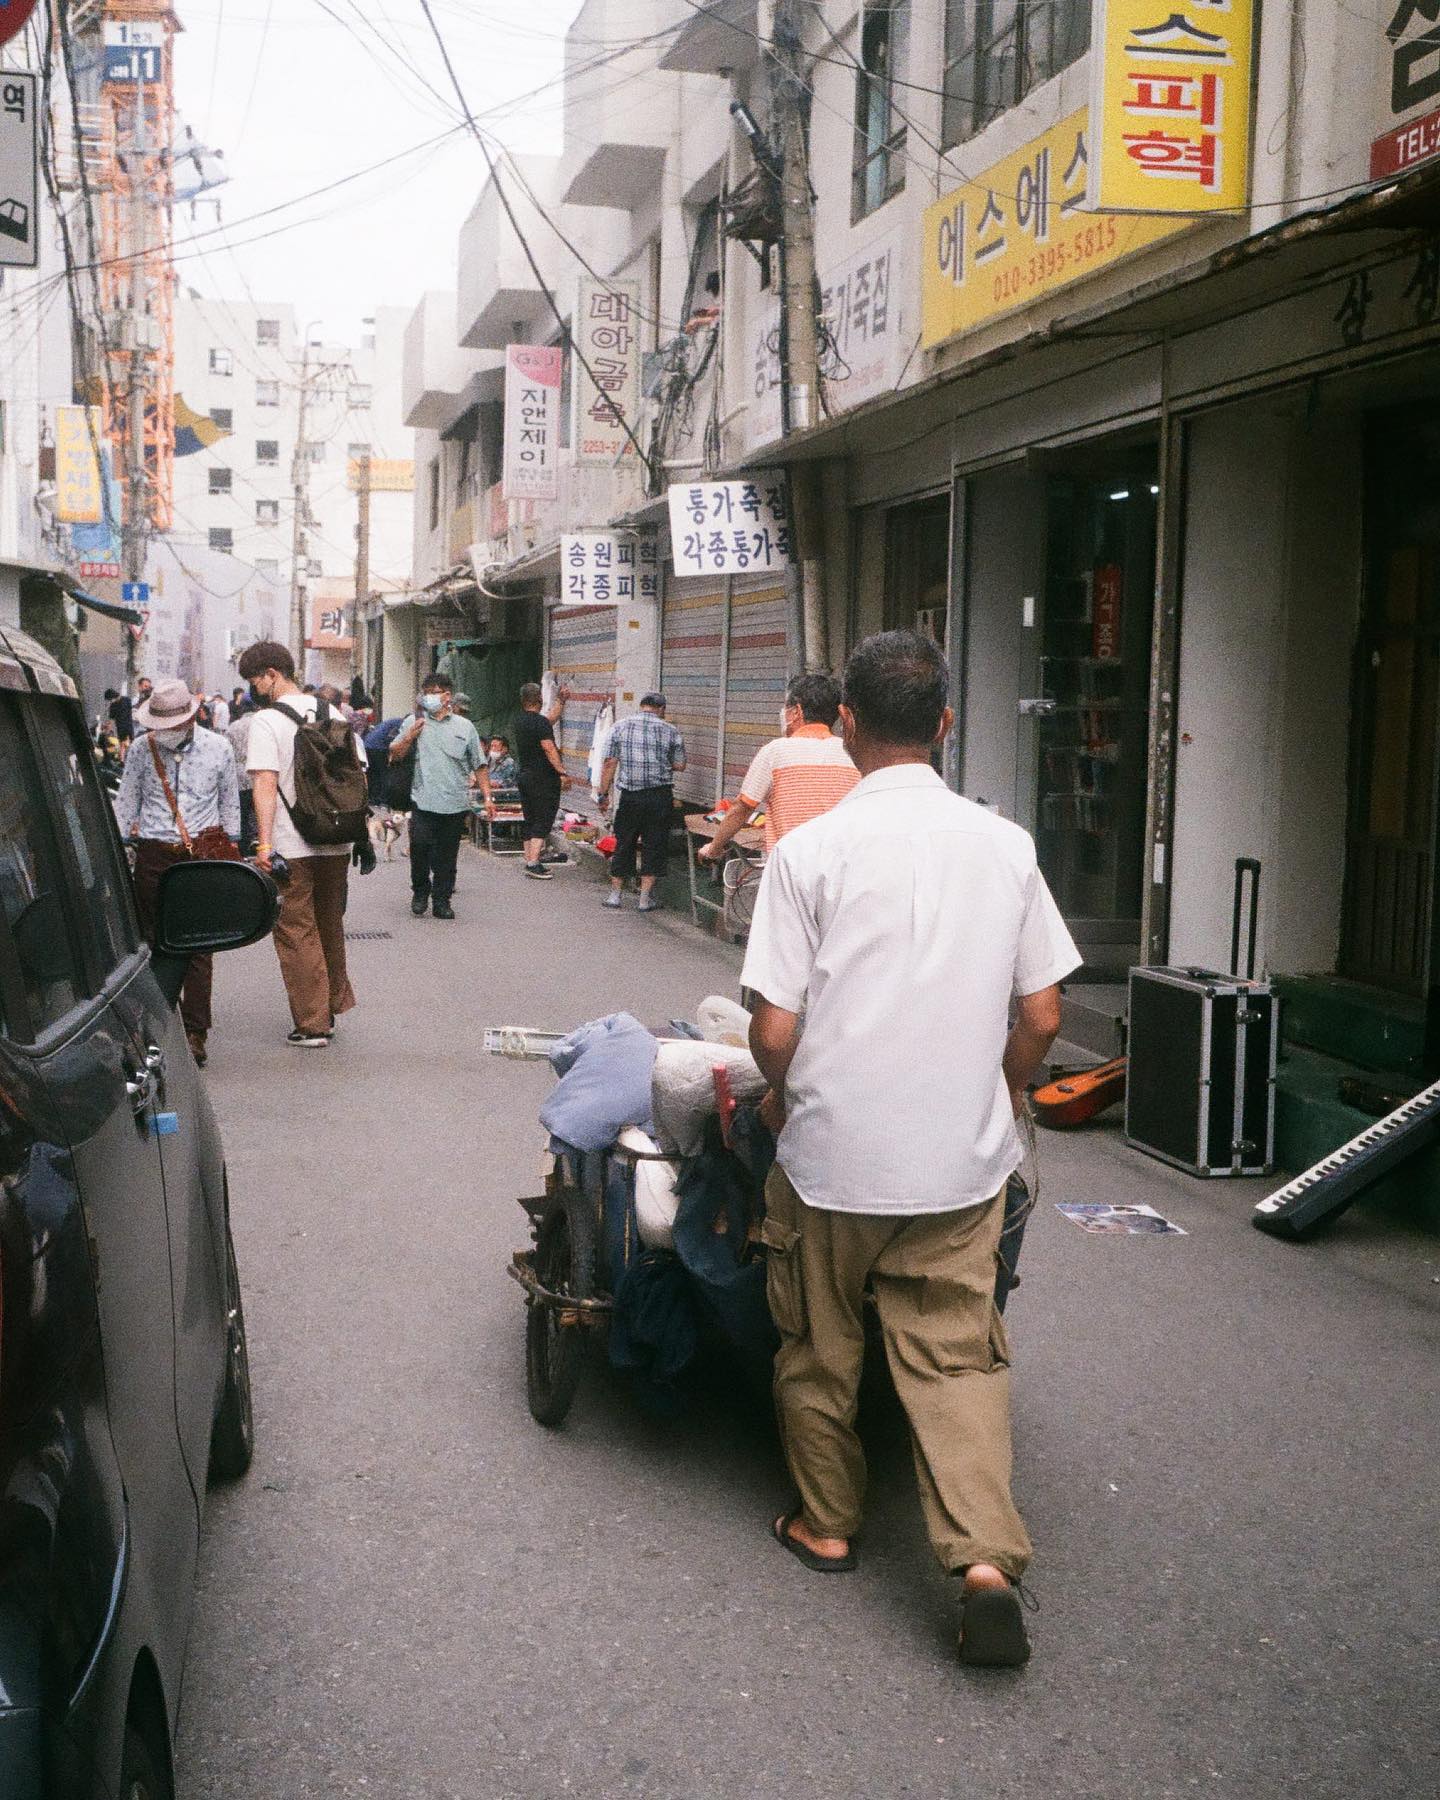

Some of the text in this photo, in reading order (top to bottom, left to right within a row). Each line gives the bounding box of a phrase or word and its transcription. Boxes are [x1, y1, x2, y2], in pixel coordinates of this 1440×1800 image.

[991, 217, 1118, 302] 010-3395-5815
[588, 292, 634, 429] 대아금속
[519, 388, 548, 466] 지앤제이
